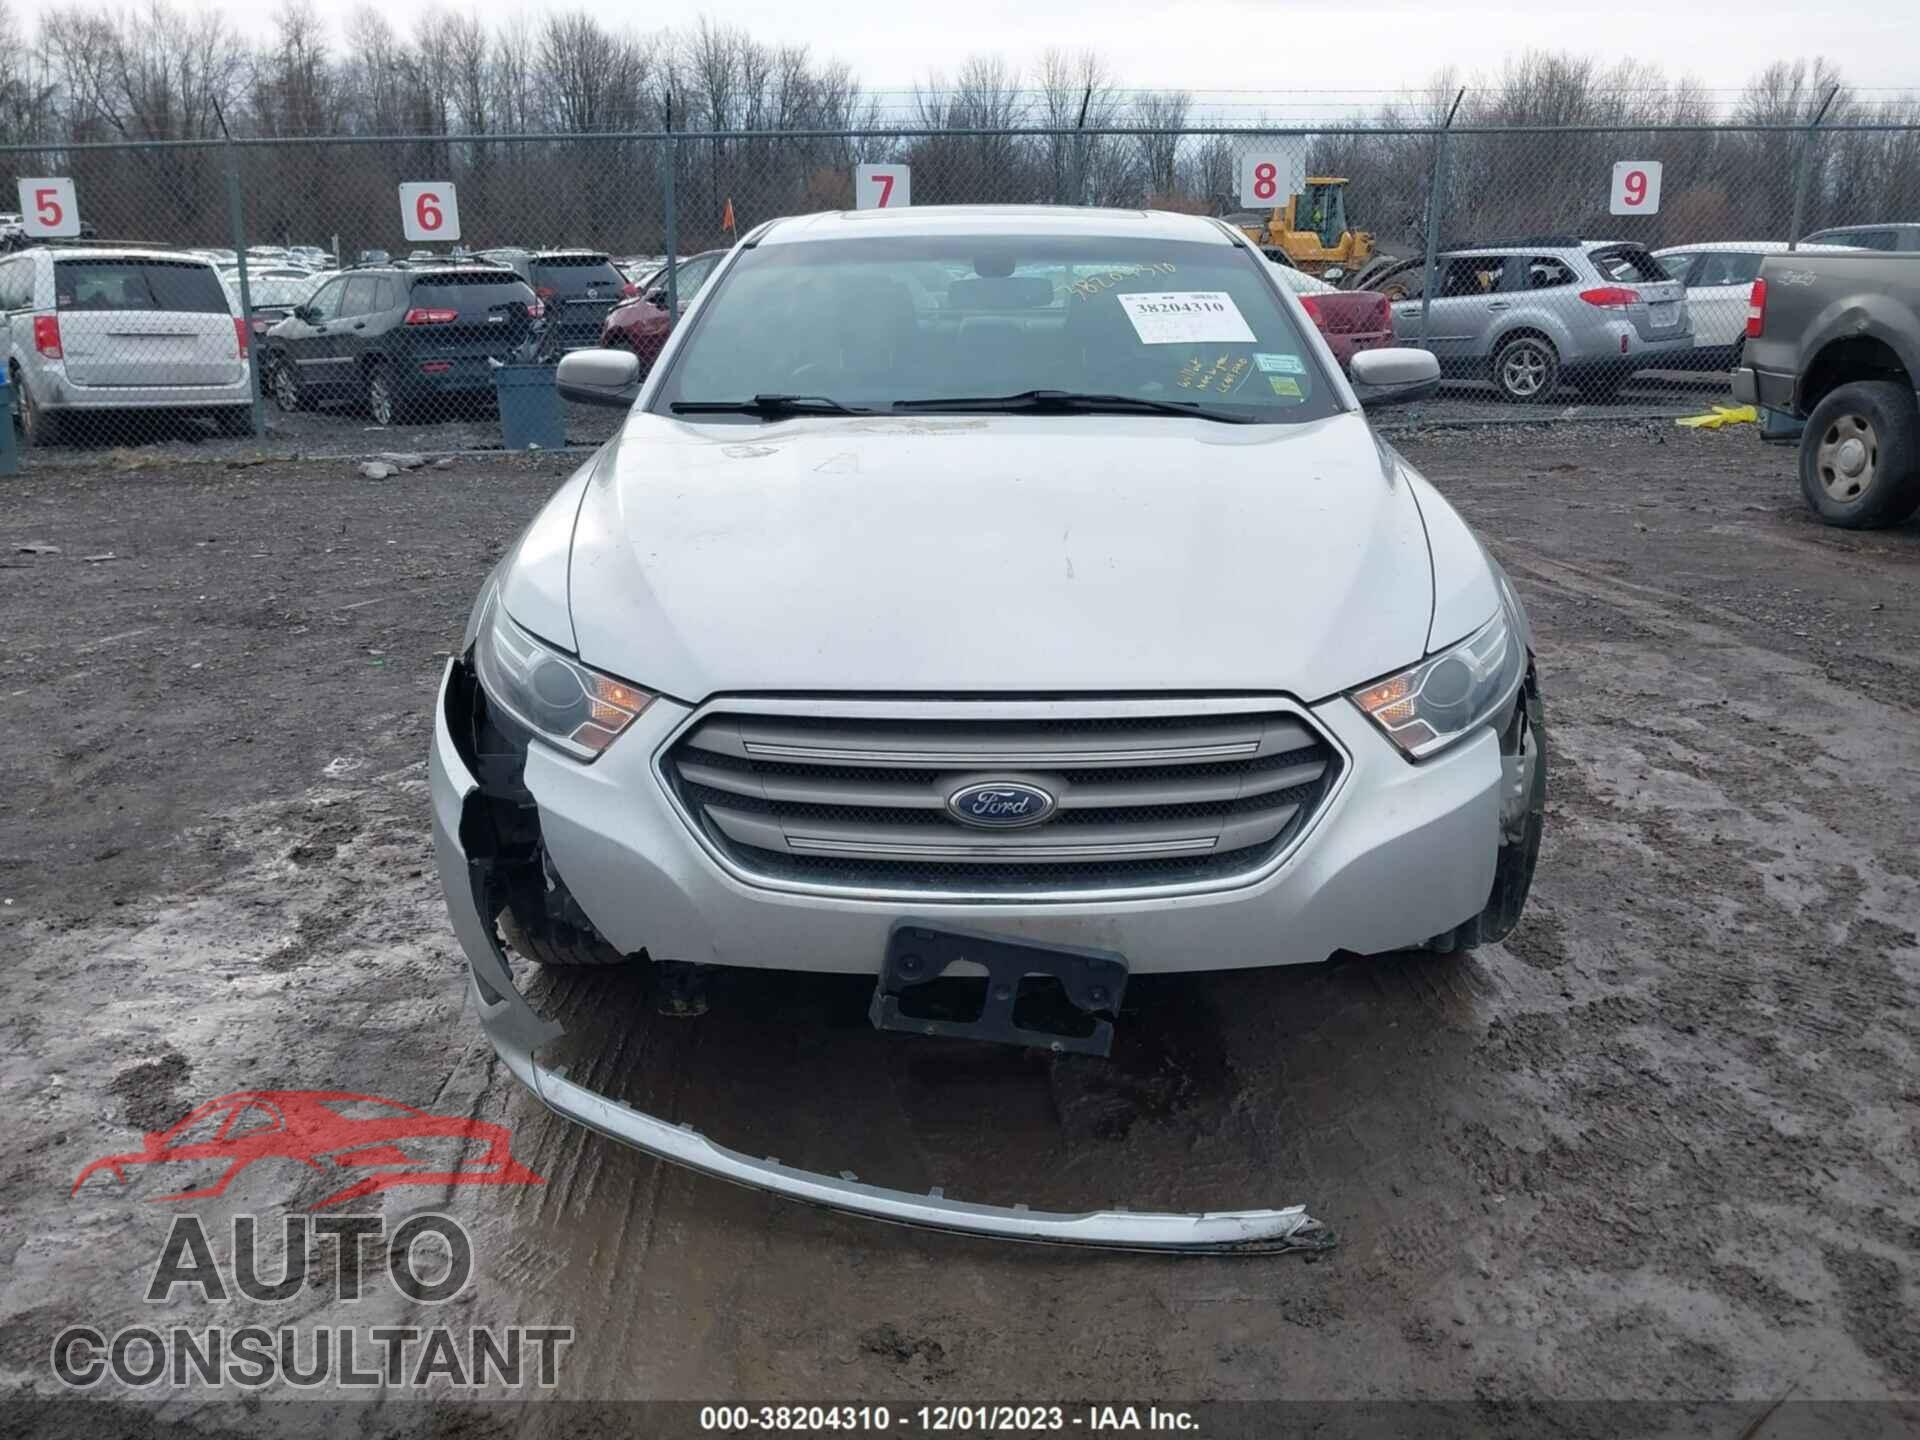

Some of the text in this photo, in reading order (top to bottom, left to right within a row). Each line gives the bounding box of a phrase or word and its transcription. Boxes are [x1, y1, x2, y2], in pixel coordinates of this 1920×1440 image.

[871, 175, 894, 208] 7
[1254, 163, 1277, 199] 8
[1624, 170, 1648, 206] 9
[35, 188, 64, 227] 5
[416, 192, 443, 232] 6
[1136, 302, 1225, 313] 38204310
[972, 790, 1030, 814] Ford
